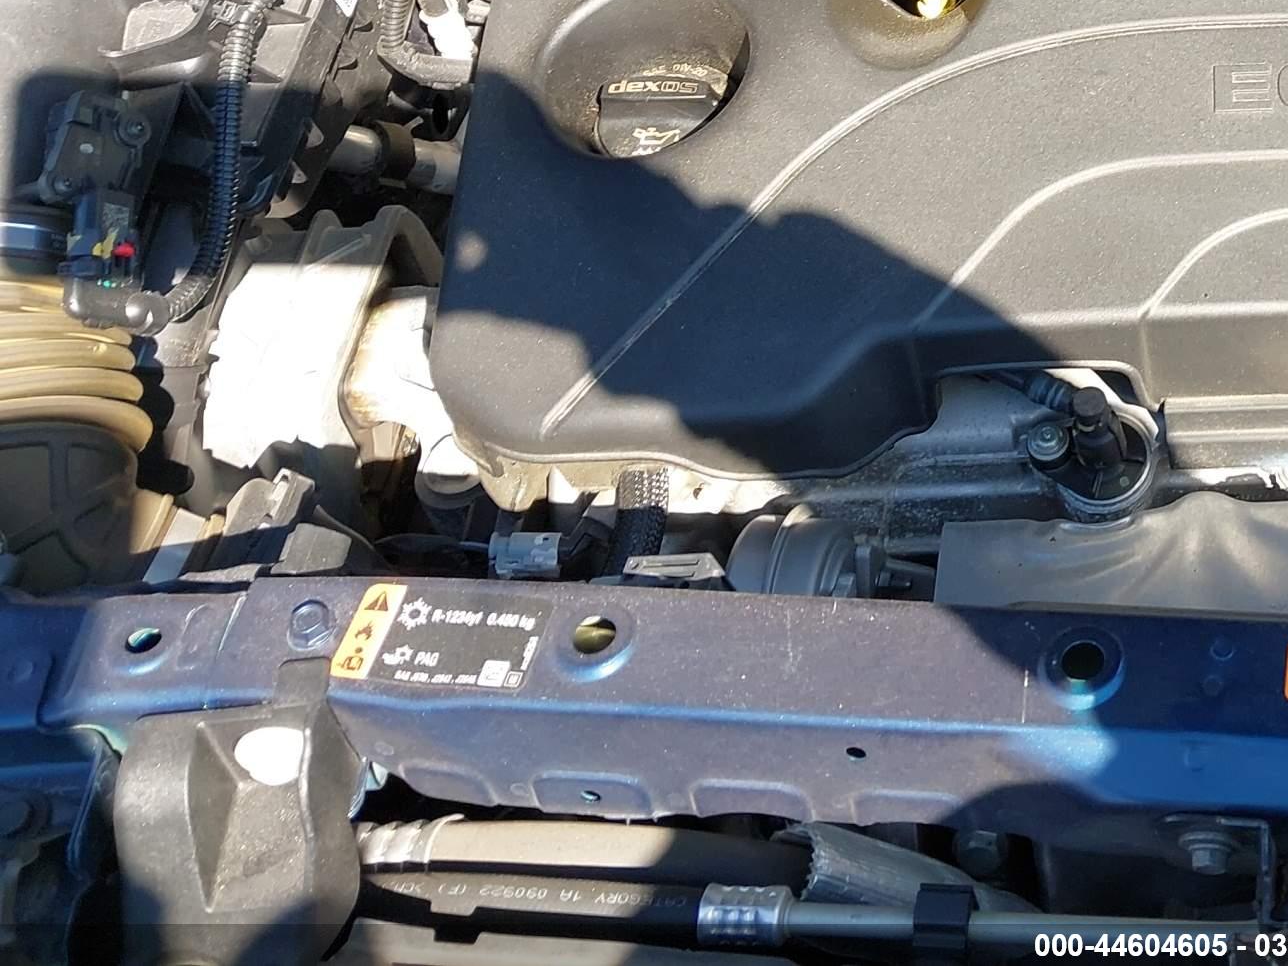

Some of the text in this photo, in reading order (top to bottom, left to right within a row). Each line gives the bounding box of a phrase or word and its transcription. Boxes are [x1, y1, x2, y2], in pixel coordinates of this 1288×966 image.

[607, 79, 699, 94] dexos
[519, 615, 536, 631] kg
[414, 651, 440, 667] PAG
